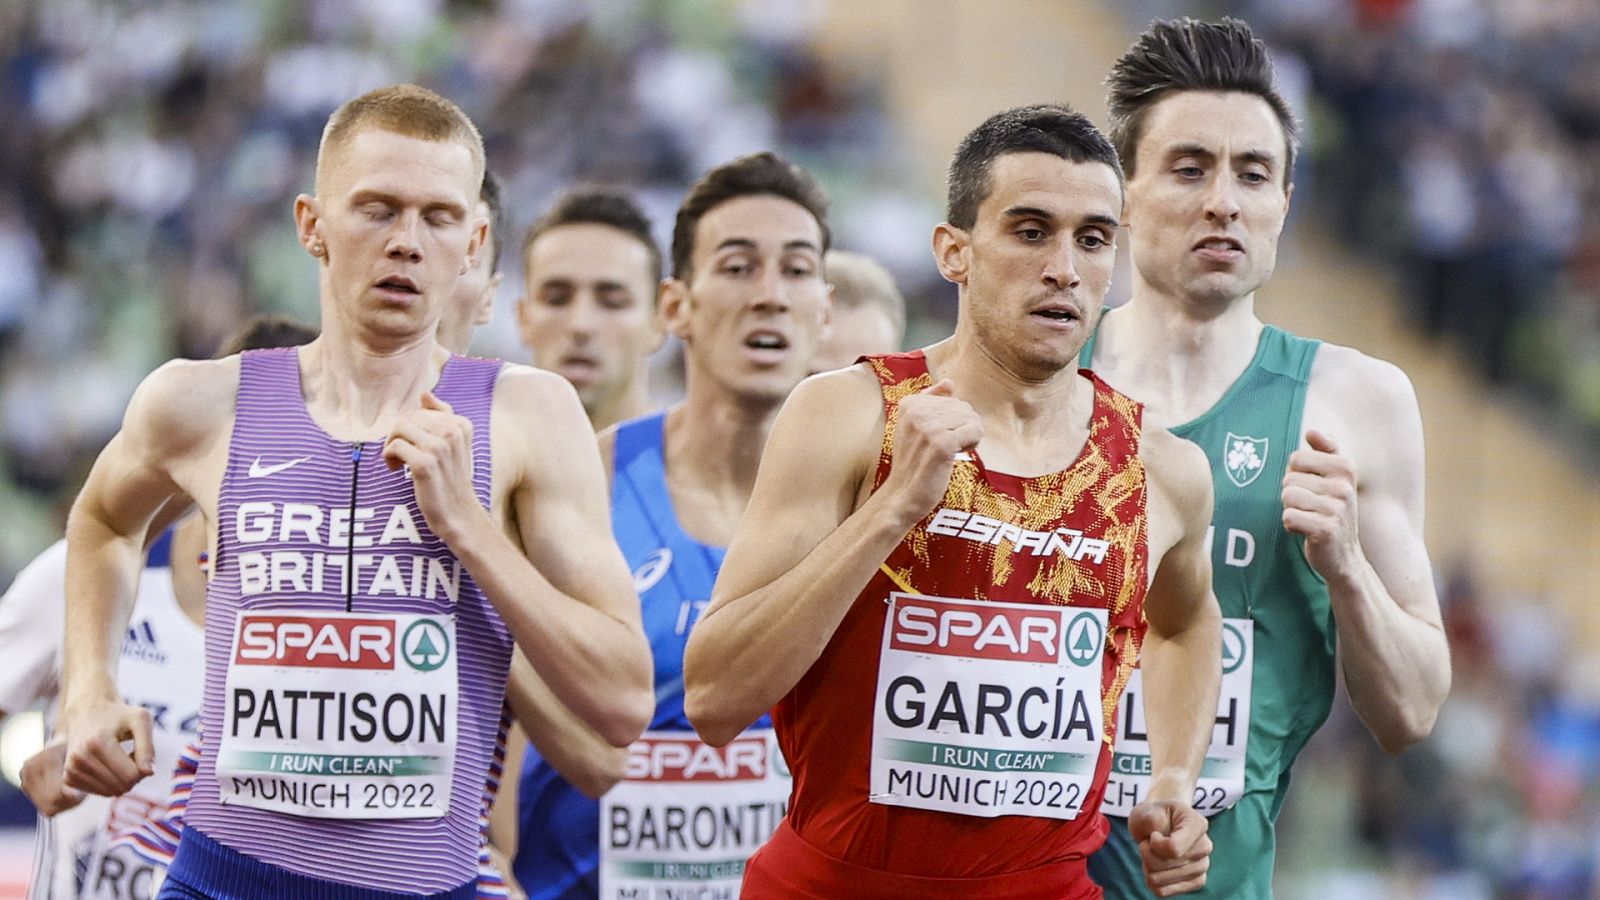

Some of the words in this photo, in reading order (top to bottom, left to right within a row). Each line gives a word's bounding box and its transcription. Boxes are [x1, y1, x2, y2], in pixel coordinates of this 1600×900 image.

[236, 502, 422, 547] GREA
[926, 508, 1111, 565] ESPAÑA
[238, 552, 461, 602] BRITAIN
[240, 622, 392, 663] SPAR
[896, 605, 1057, 656] SPAR
[231, 688, 446, 743] PATTISON
[885, 676, 1095, 741] GARCÍA
[270, 755, 276, 770] I
[281, 756, 323, 773] RUN
[628, 742, 765, 779] SPAR
[932, 746, 938, 762] I
[944, 748, 988, 768] RUN
[1118, 756, 1152, 774] CLE
[232, 777, 350, 808] MUNICH
[364, 783, 435, 808] 2022
[888, 768, 1008, 807] MUNICH
[1013, 779, 1081, 810] 2022
[1192, 787, 1227, 810] 22
[610, 802, 787, 849] BARONTI
